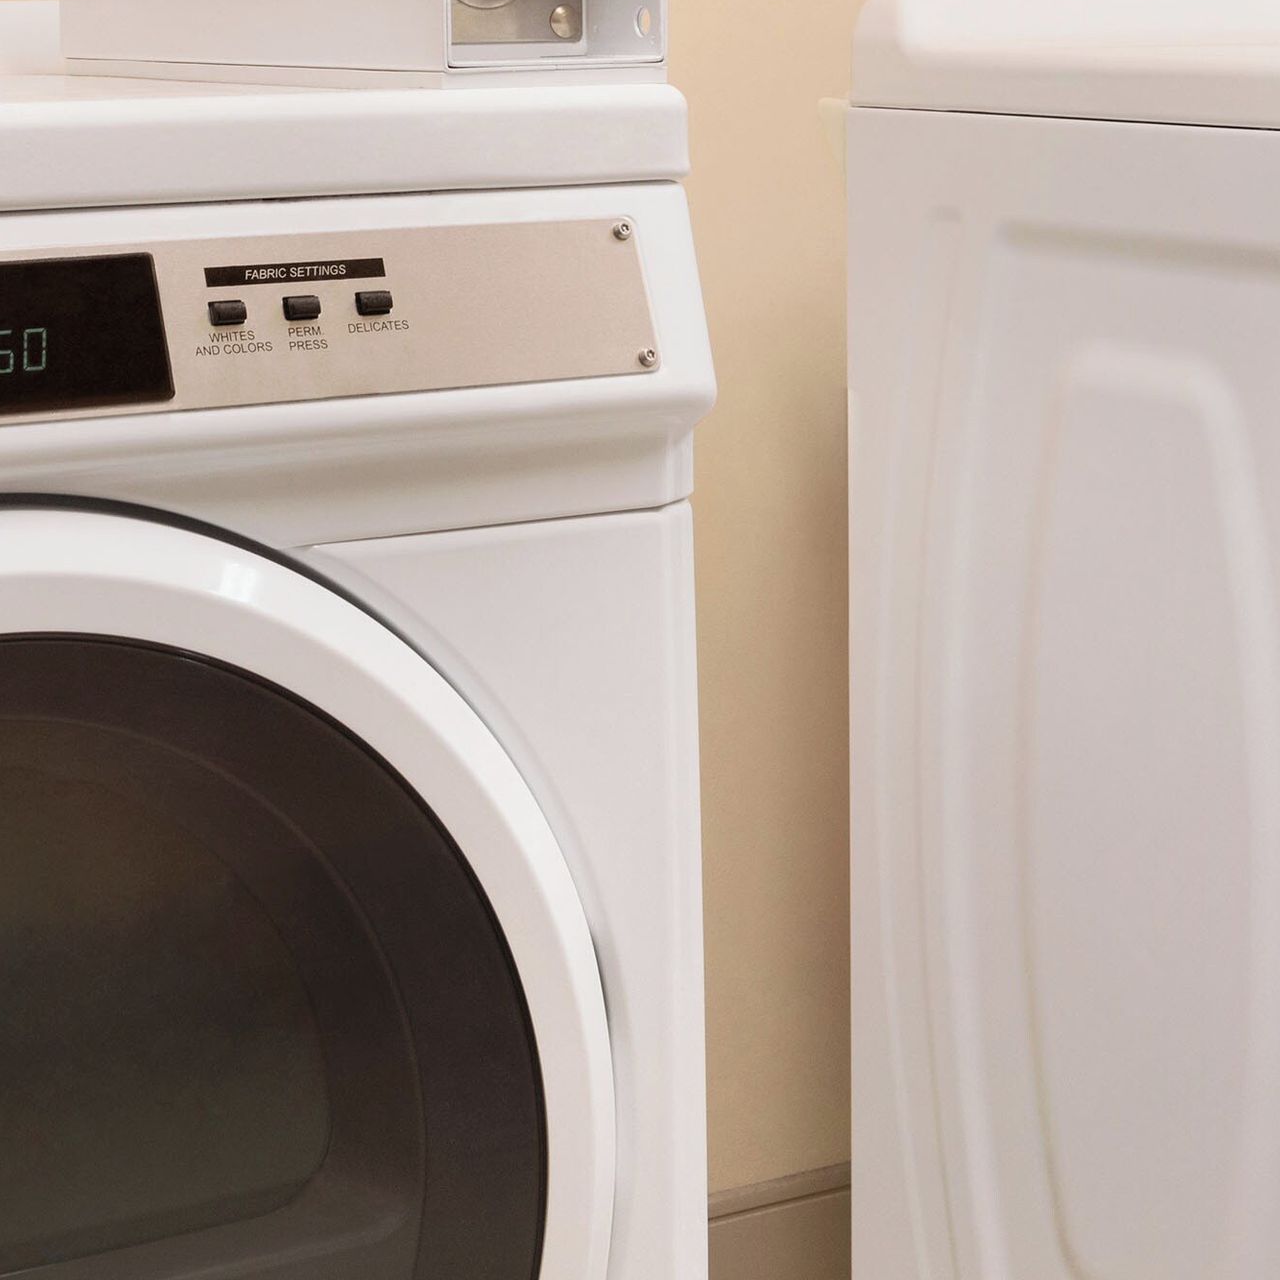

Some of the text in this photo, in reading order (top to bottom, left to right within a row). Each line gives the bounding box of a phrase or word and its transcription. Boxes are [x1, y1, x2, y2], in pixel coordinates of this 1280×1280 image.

[244, 264, 346, 281] FABRIC SETTINGS
[348, 320, 409, 334] DELICATES
[208, 330, 255, 343] WHITES
[196, 342, 273, 356] AND COLORS
[289, 340, 328, 351] PRESS
